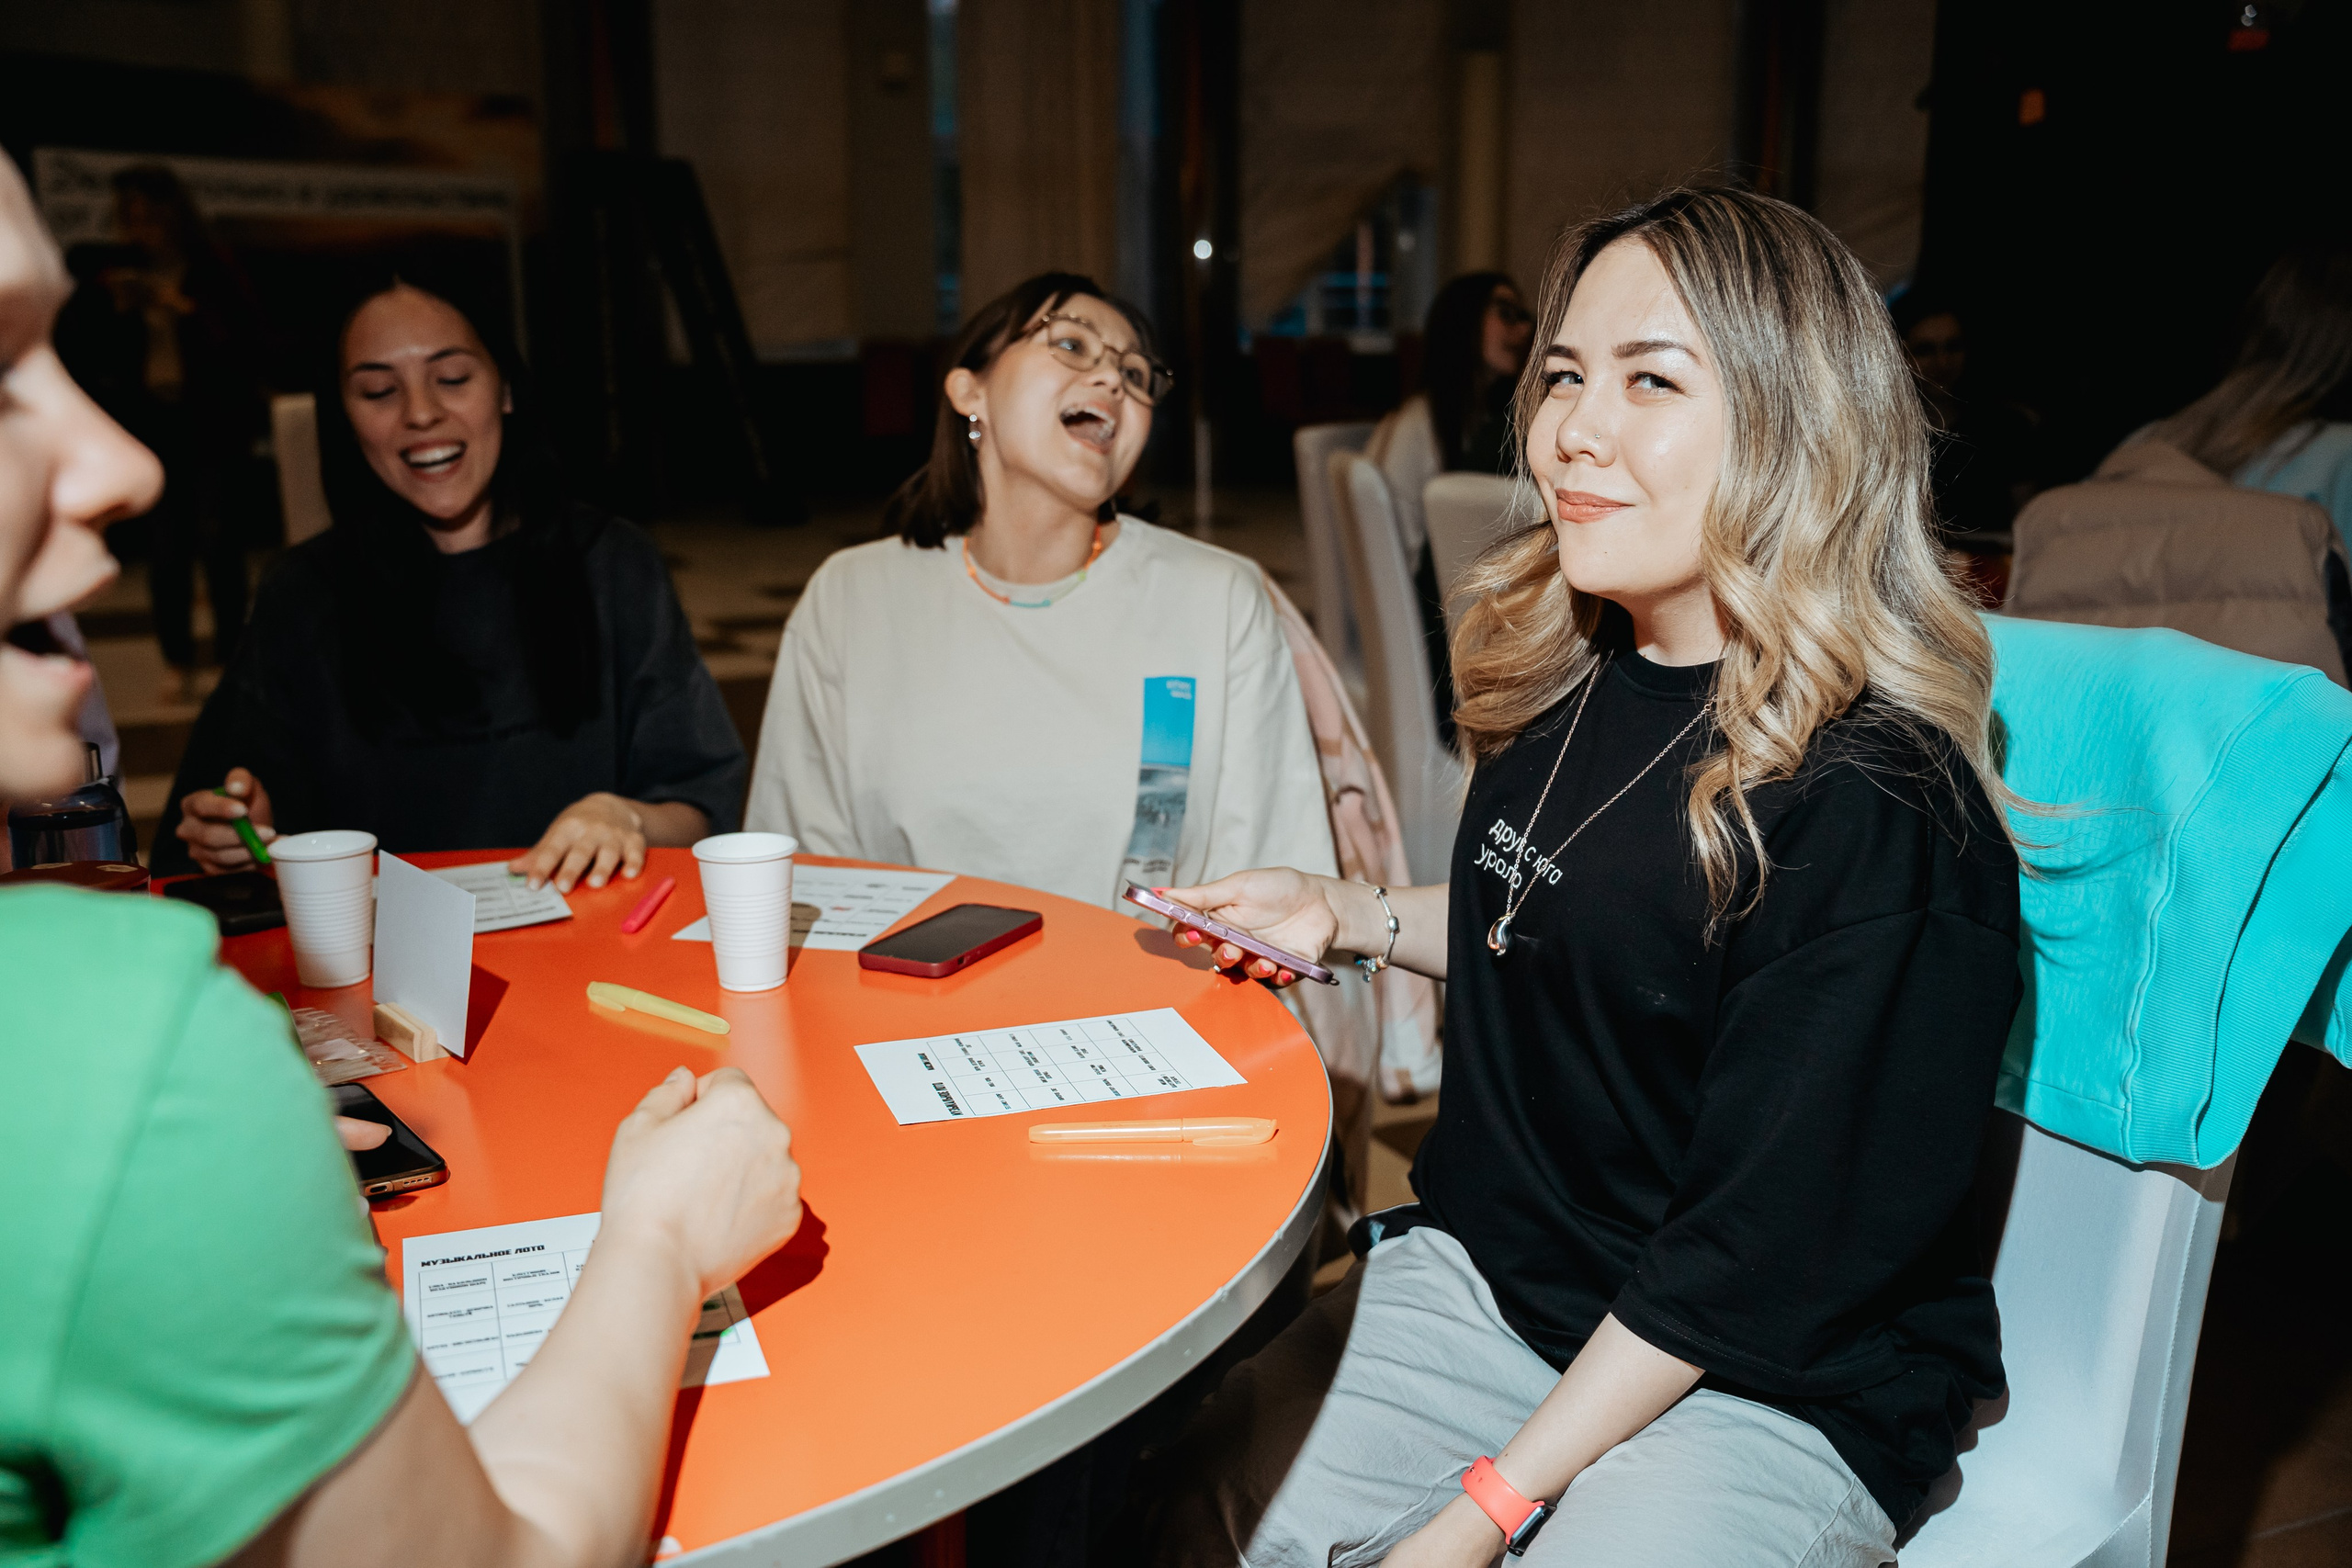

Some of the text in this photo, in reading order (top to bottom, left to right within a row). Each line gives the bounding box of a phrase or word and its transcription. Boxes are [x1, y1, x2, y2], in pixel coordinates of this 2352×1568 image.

[1474, 843, 1522, 889] урала
[1524, 846, 1537, 862] с
[1532, 854, 1564, 886] юга
[421, 1245, 546, 1268] МУЗЫКАЛЬНОЕ ЛОТО
